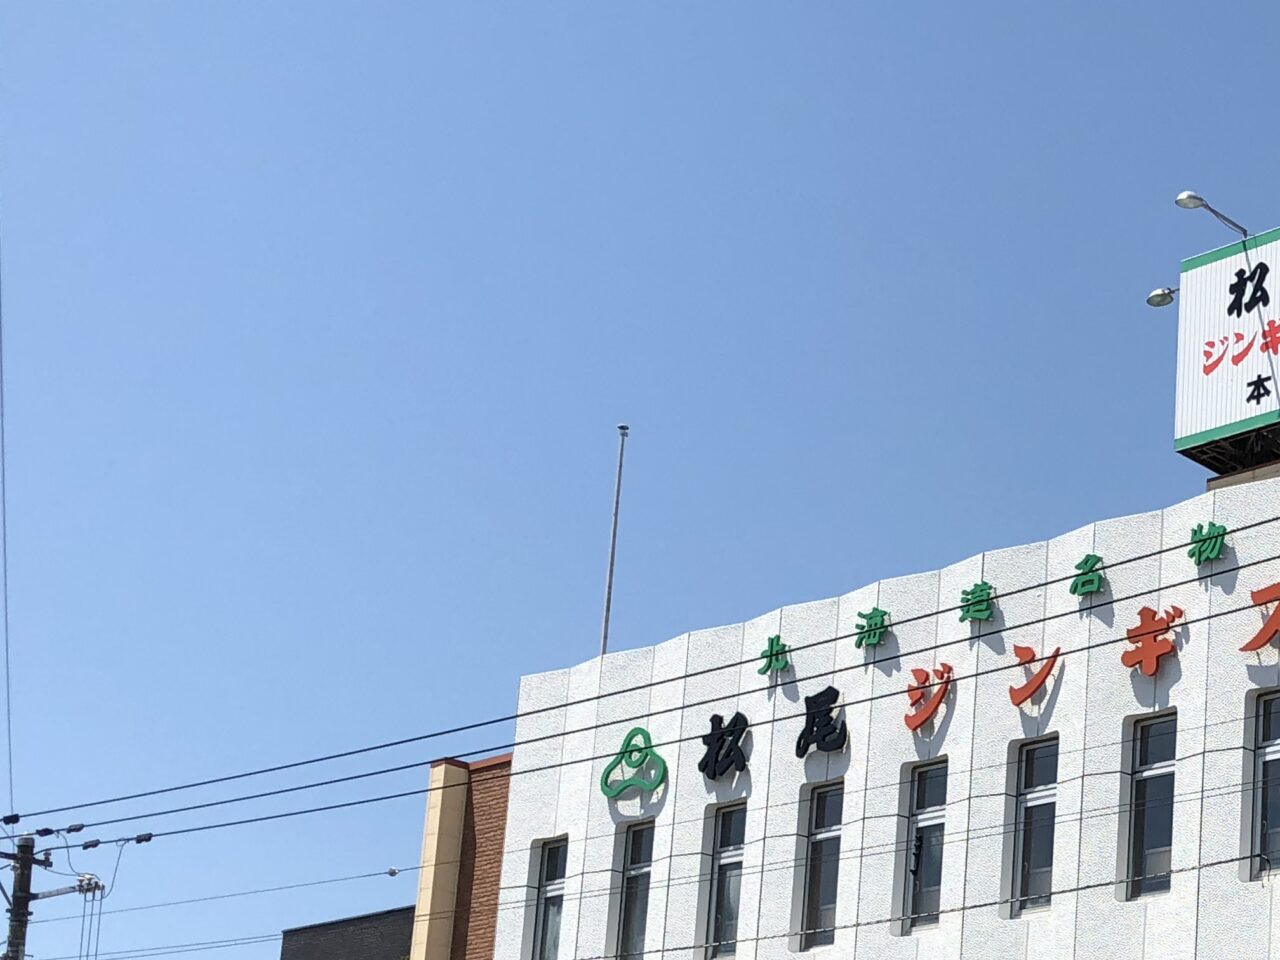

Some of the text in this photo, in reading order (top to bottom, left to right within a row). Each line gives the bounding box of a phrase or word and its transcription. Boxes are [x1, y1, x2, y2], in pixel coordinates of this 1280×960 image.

[757, 521, 1227, 675] 北海道名物
